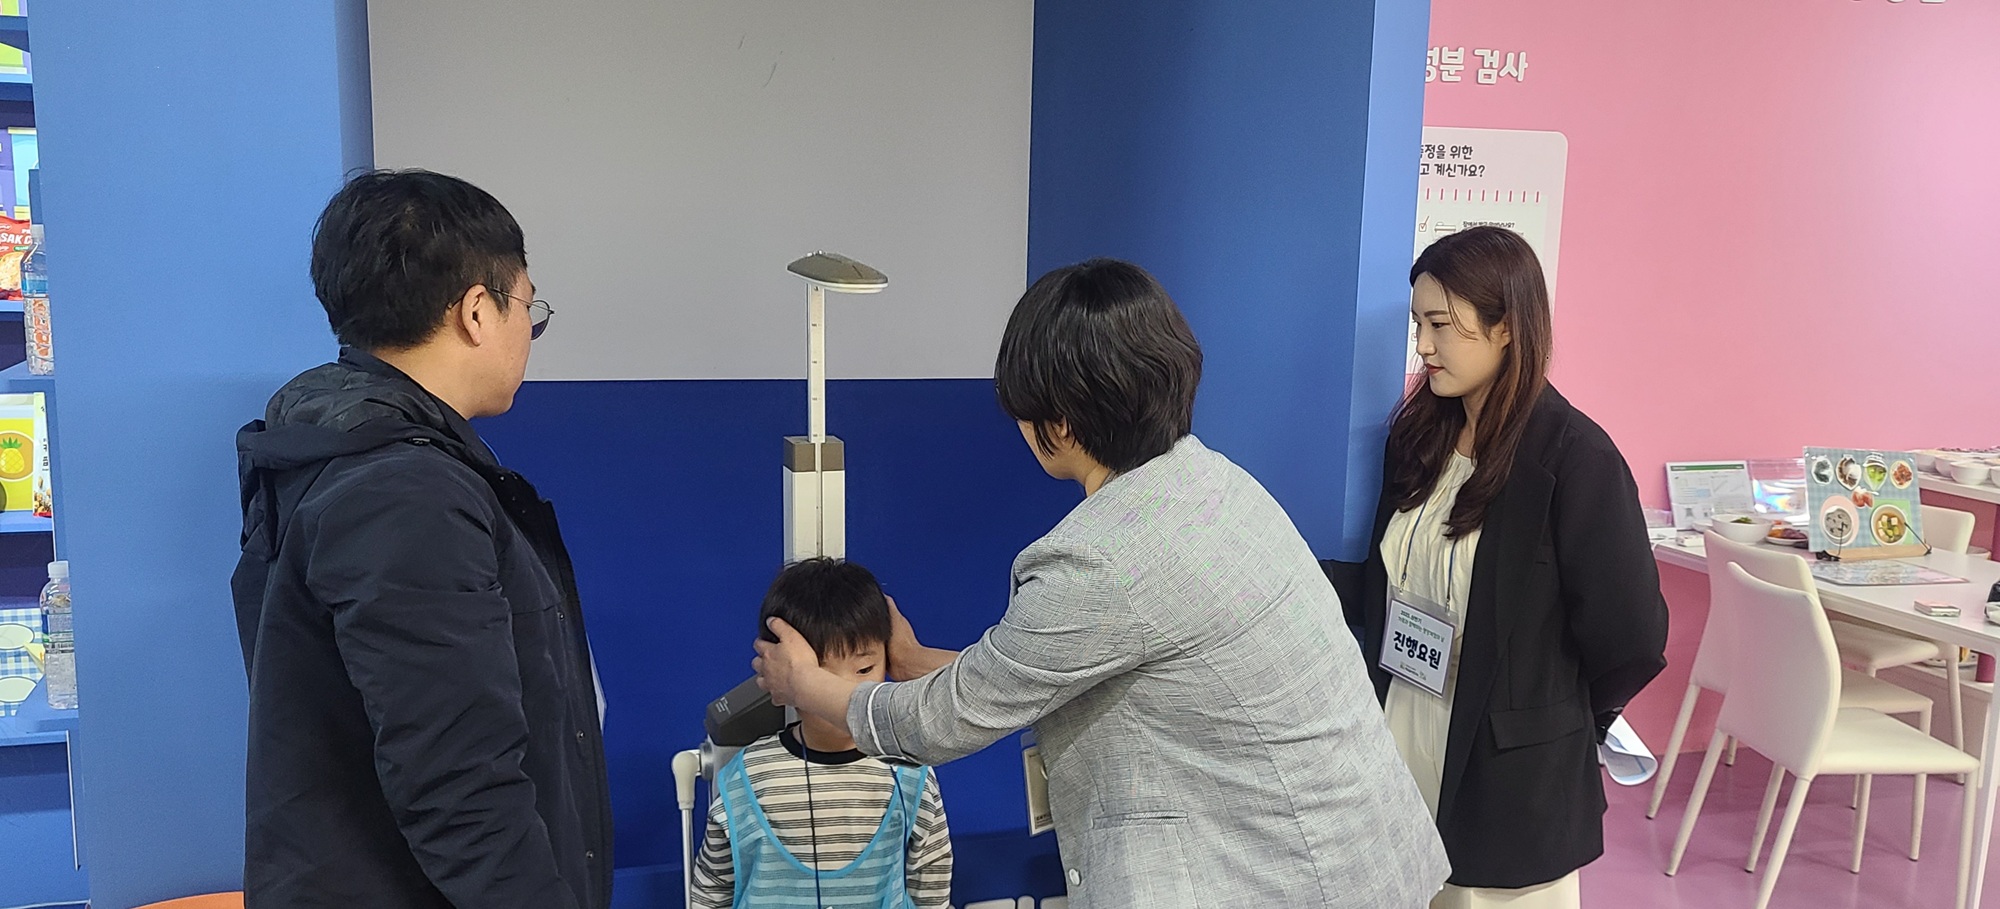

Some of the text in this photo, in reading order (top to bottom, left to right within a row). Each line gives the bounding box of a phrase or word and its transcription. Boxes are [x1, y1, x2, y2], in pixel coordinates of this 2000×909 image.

[1474, 48, 1529, 84] 검사
[1421, 144, 1473, 160] 정을 위한
[1434, 163, 1486, 178] 계신가요?
[0, 232, 23, 245] SAK
[1393, 630, 1442, 670] 진행요원
